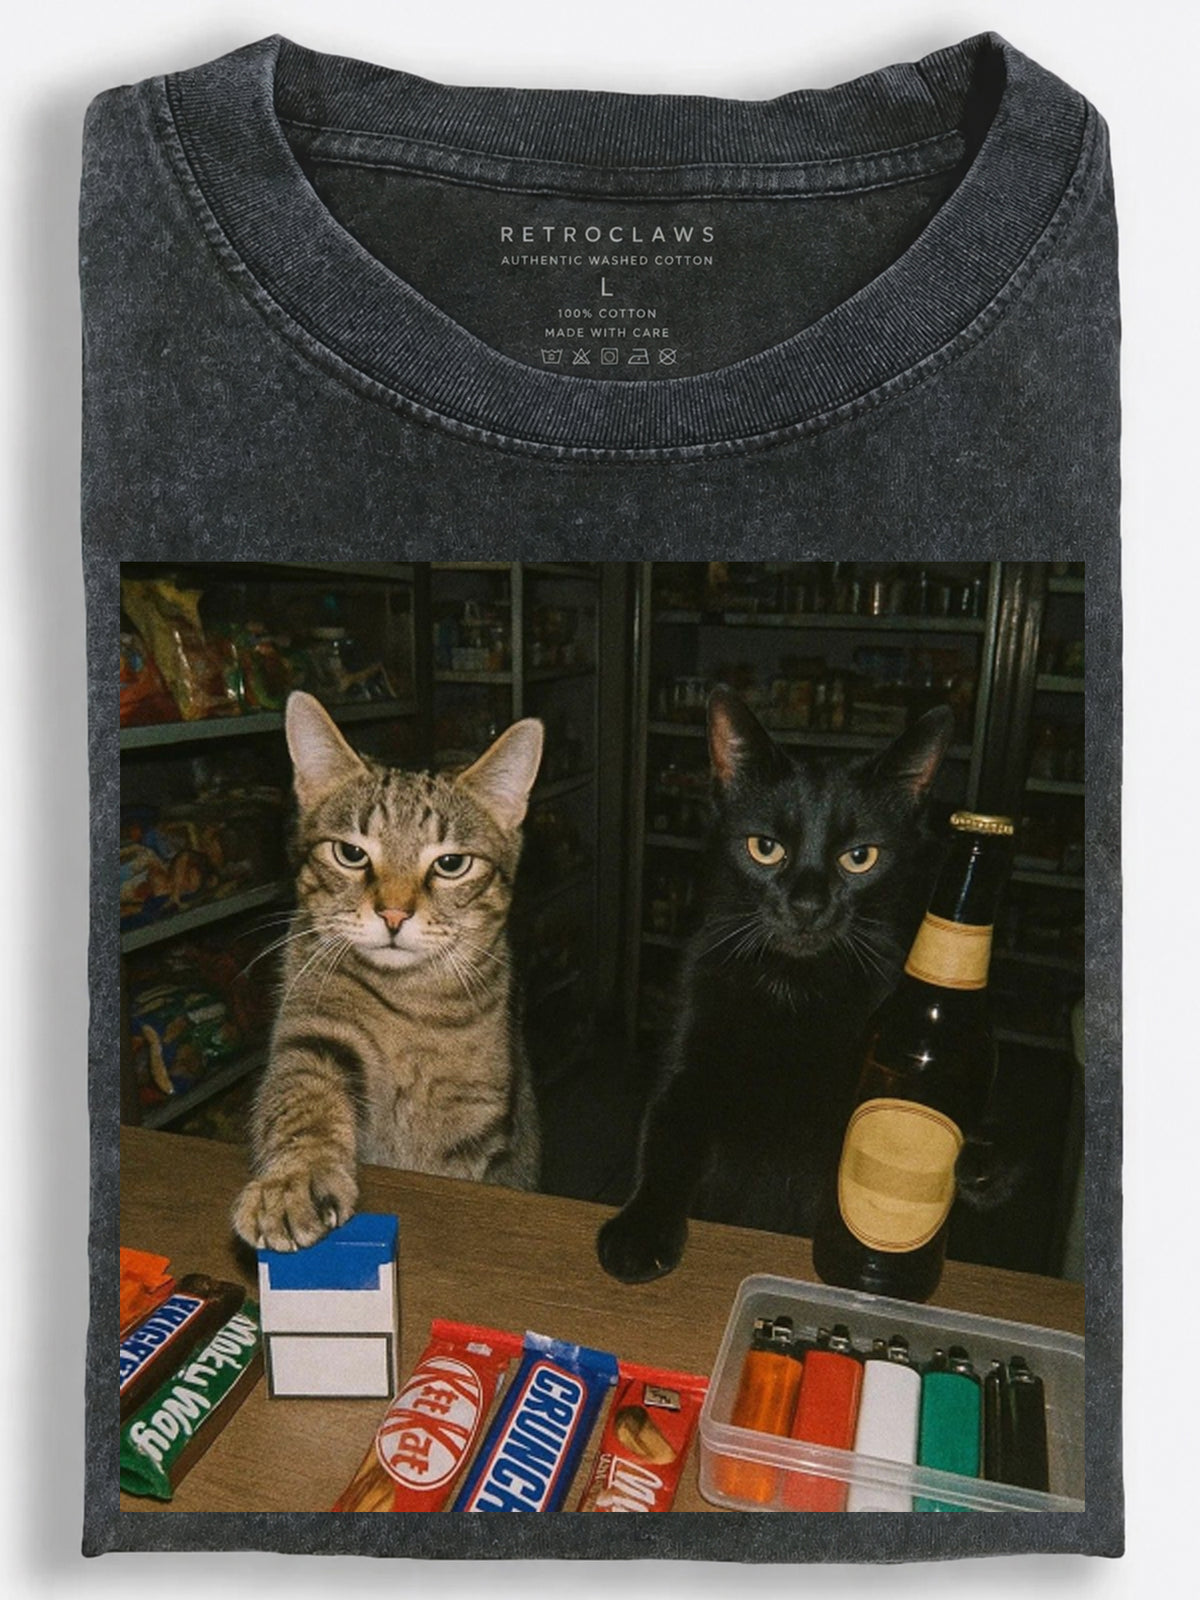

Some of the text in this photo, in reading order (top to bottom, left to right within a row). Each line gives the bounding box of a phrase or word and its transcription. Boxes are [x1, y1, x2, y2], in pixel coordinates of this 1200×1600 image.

[500, 226, 715, 243] RETROCLAWS
[501, 255, 713, 266] AUTHENTIC WASHED COTTON
[601, 276, 614, 297] L
[558, 308, 657, 319] 100% COTTON
[544, 327, 670, 338] MADE WITH CARE
[129, 1385, 212, 1466] Way
